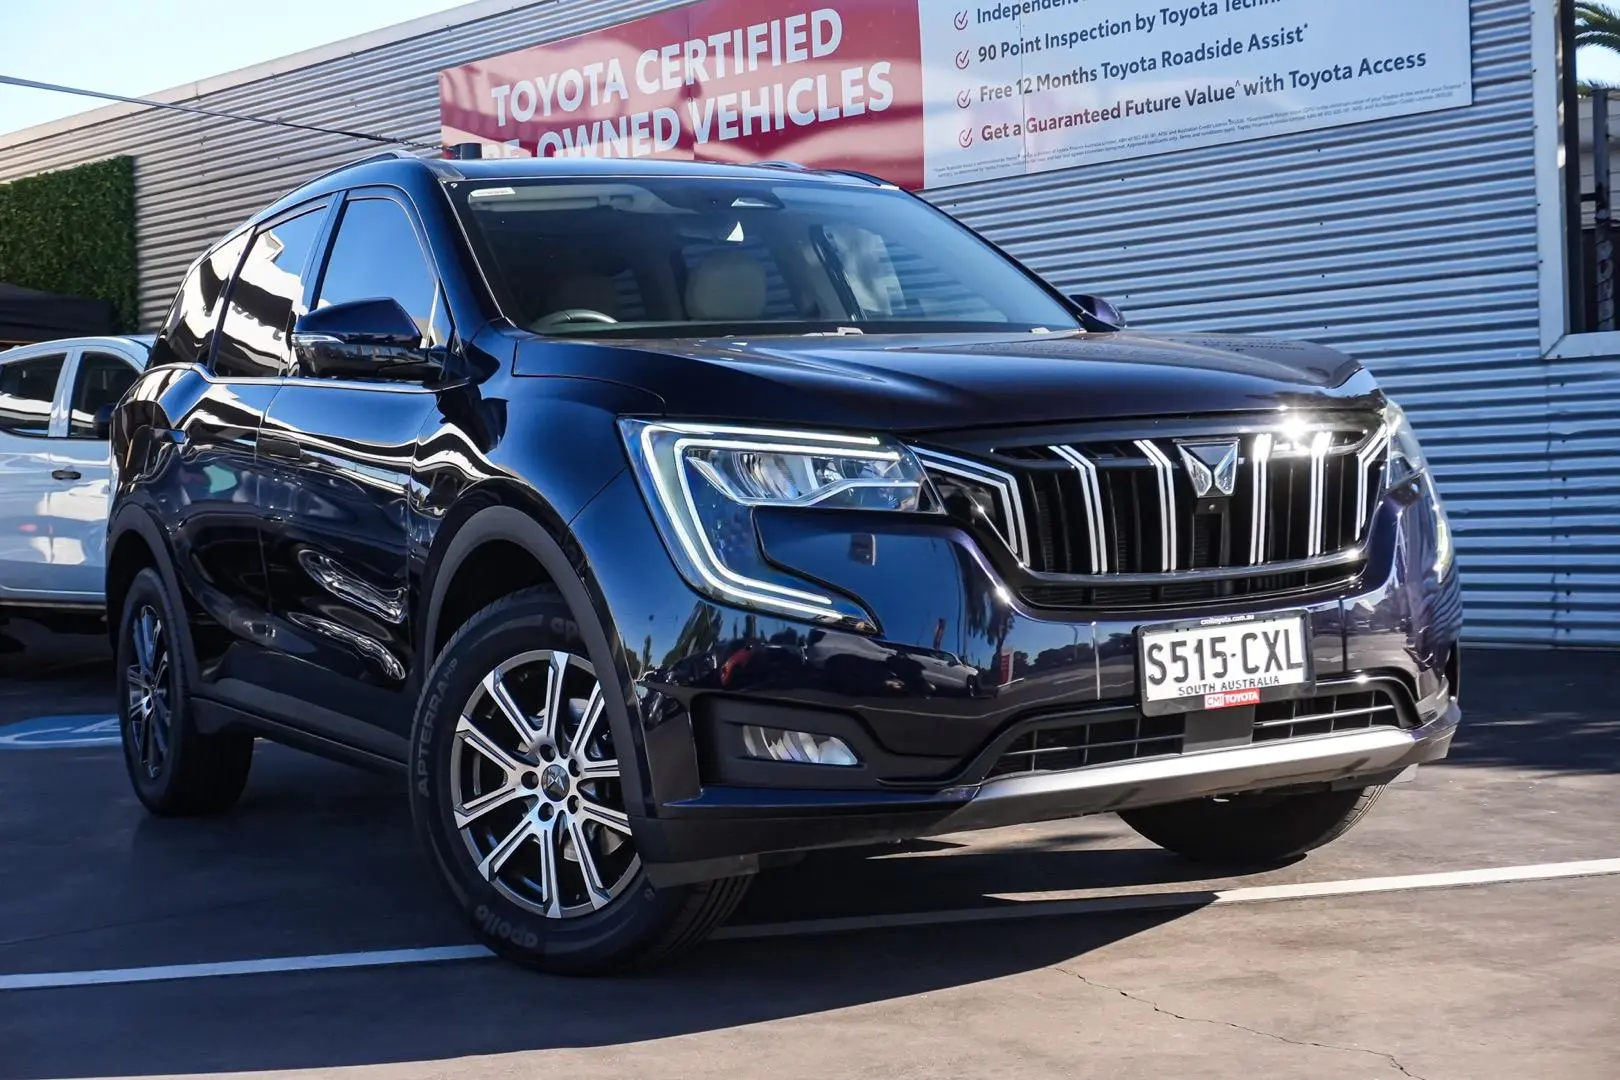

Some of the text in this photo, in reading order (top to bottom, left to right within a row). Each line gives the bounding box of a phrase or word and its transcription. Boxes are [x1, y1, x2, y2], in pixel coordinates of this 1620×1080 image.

[978, 44, 997, 63] 90
[1001, 36, 1042, 58] Point
[1045, 19, 1132, 49] Inspection
[1136, 13, 1156, 33] by
[1160, 1, 1218, 27] Toyota
[491, 8, 843, 127] TOYOTA CERTIFIED
[980, 82, 1013, 103] Free
[1015, 78, 1033, 96] 12
[1037, 67, 1098, 92] Months
[1101, 56, 1157, 81] Toyota
[1162, 38, 1243, 69] Roadside
[981, 123, 1010, 142] Get
[1012, 124, 1022, 137] a
[1026, 103, 1121, 134] Guaranteed
[1125, 95, 1181, 117] Future
[1243, 74, 1285, 97] with
[1288, 63, 1353, 91] Toyota
[1357, 52, 1427, 77] Access
[537, 61, 895, 159] OWNED VEHICLES
[1178, 675, 1280, 697] SOUTH AUSTRALIA
[1225, 690, 1259, 704] TOYOTA
